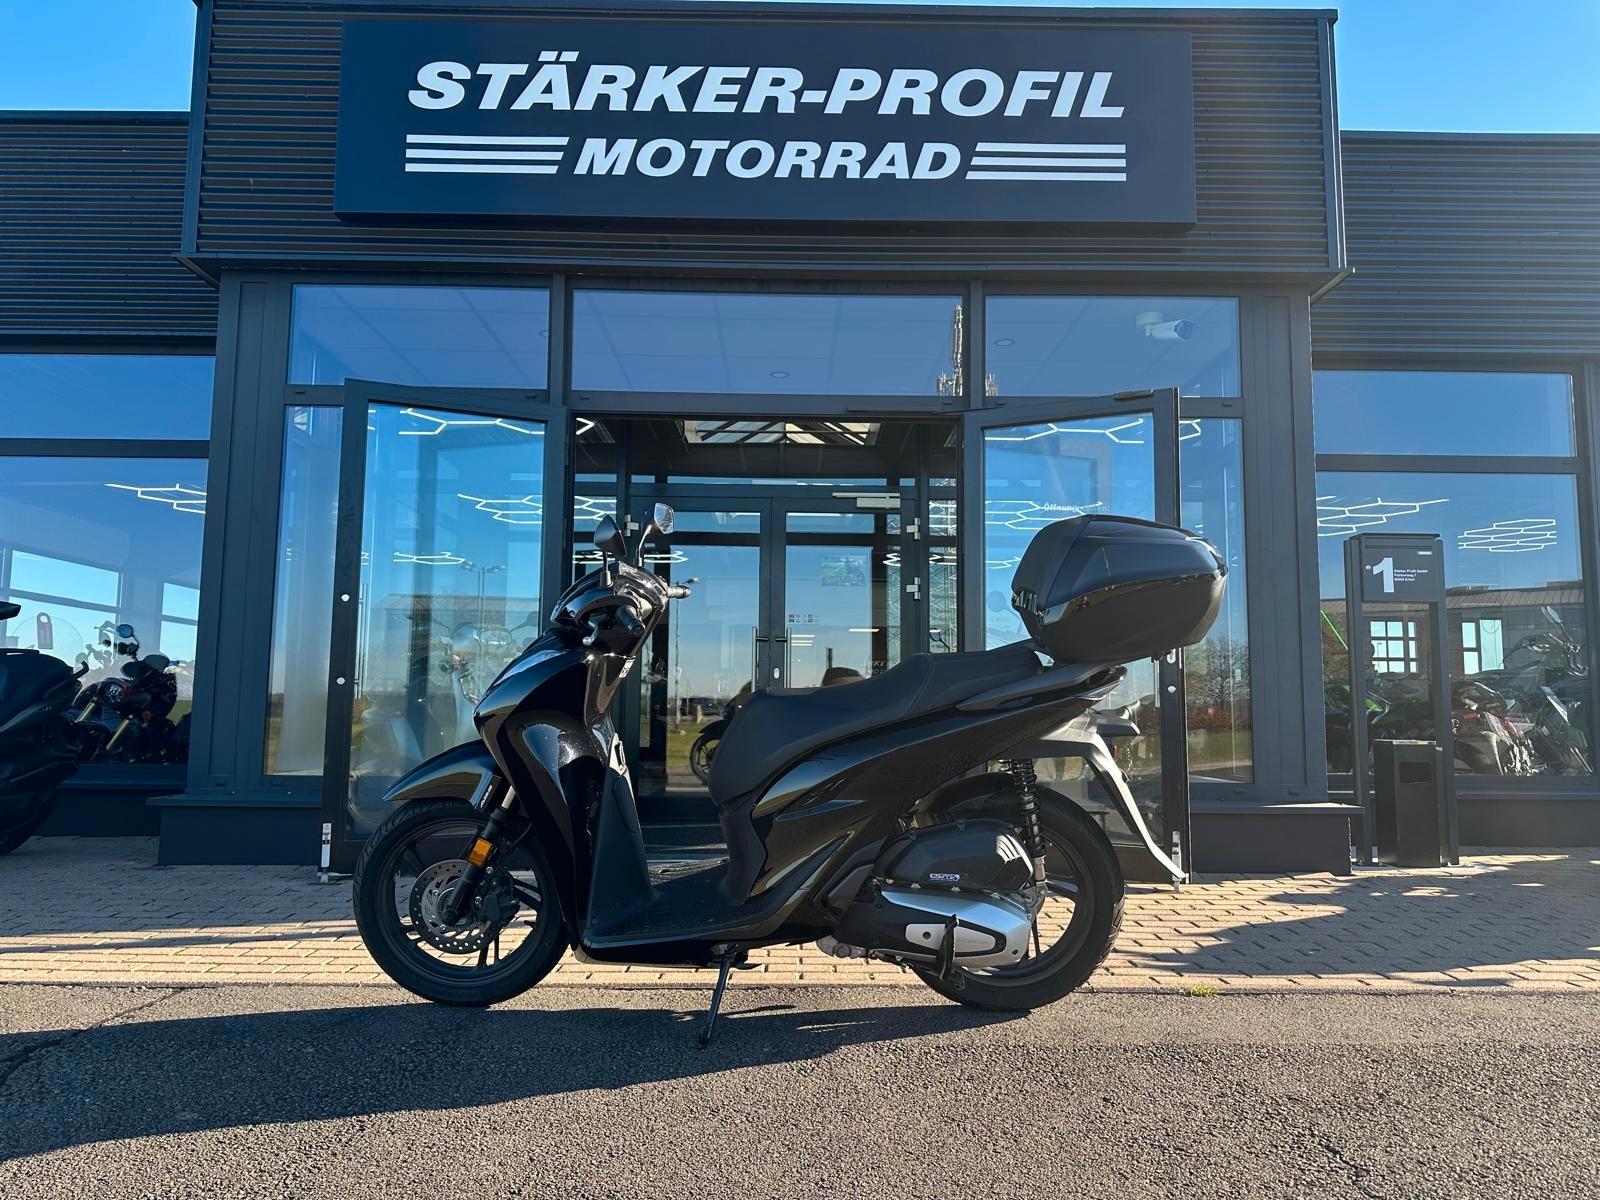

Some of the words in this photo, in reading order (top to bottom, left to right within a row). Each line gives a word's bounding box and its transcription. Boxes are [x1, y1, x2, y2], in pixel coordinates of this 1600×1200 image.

[408, 50, 1125, 118] STÄRKER-PROFIL
[572, 138, 965, 182] MOTORRAD
[1373, 557, 1394, 592] 1
